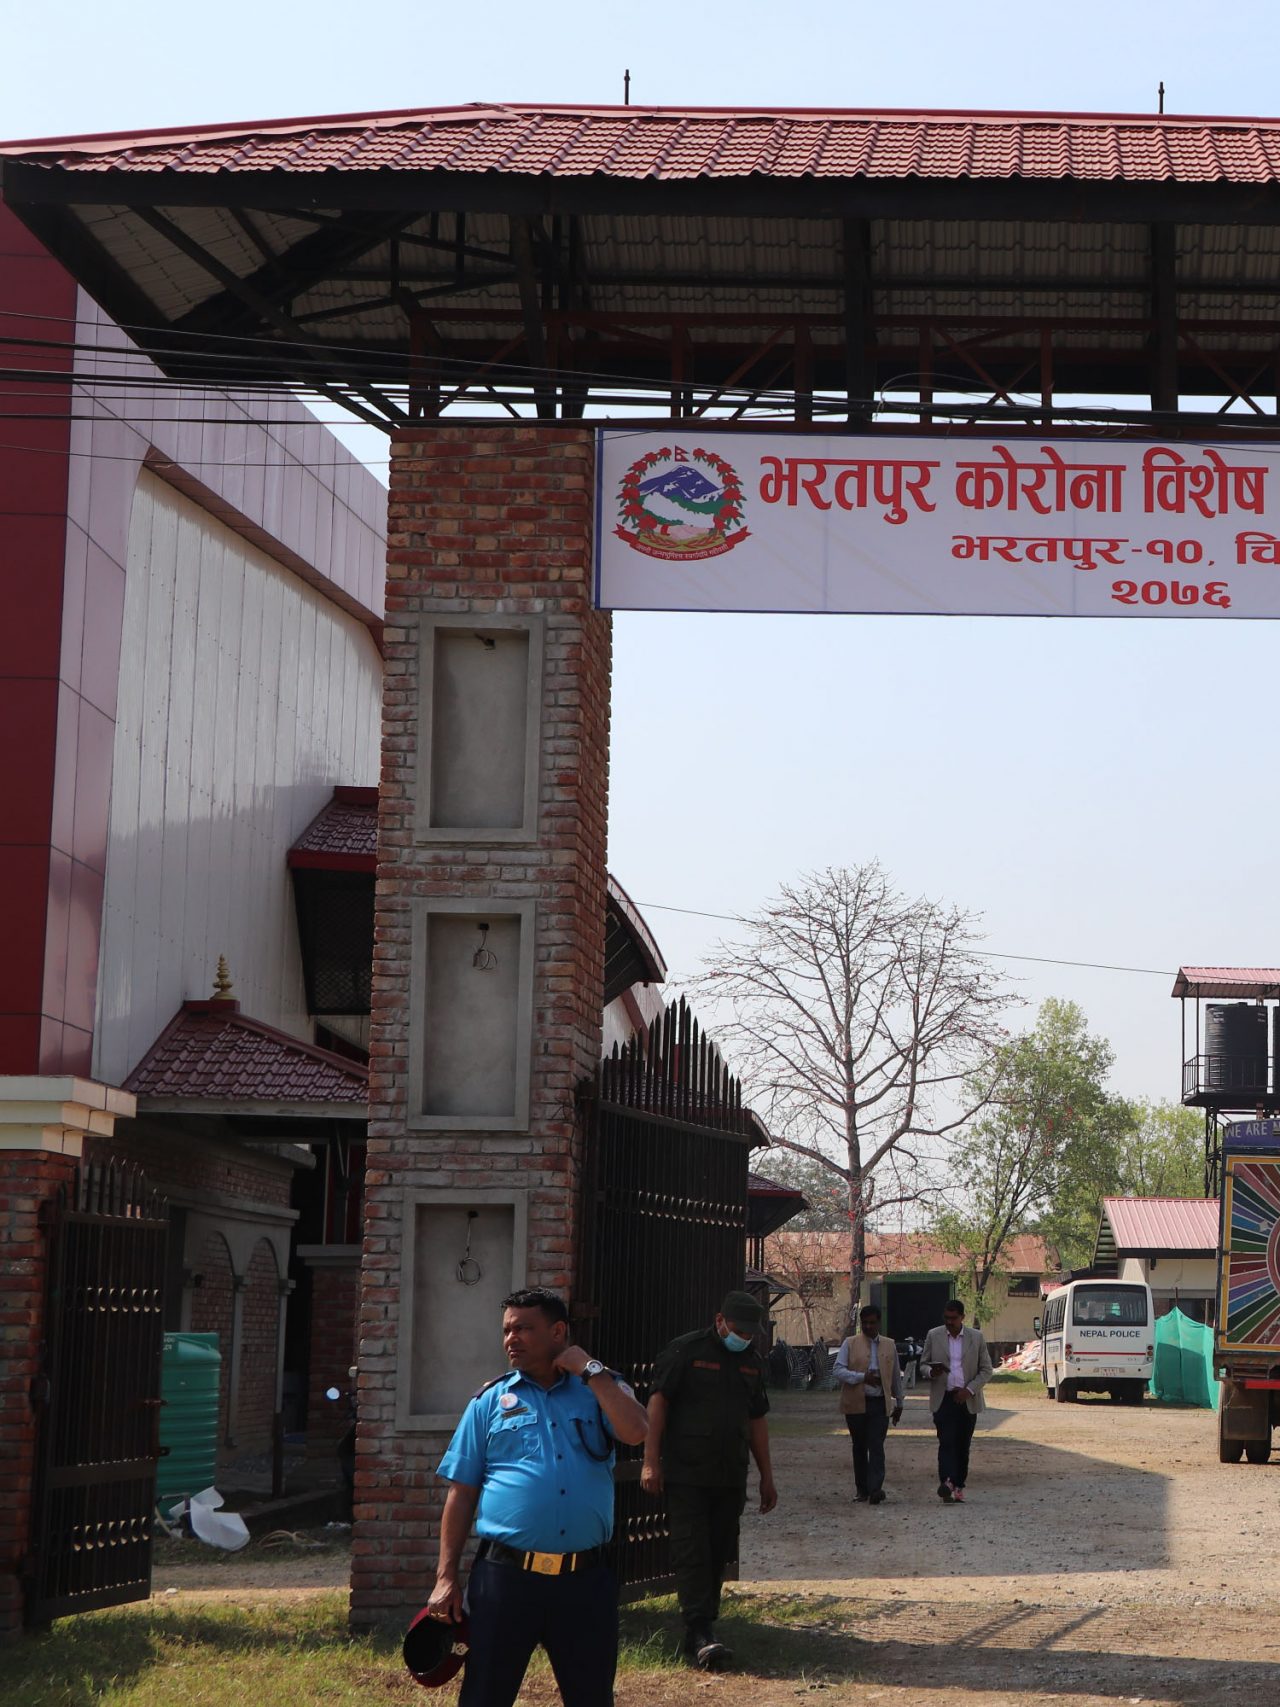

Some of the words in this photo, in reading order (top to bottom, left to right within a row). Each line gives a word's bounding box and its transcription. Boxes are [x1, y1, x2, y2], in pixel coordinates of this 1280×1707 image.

[760, 456, 940, 525] भरतपुर
[956, 446, 1127, 514] कोरोना
[1143, 447, 1268, 518] विशेष
[1111, 580, 1231, 609] २०७६
[1224, 1124, 1241, 1139] WE
[1246, 1121, 1268, 1136] ARE
[1080, 1330, 1108, 1338] NEPAL
[1110, 1330, 1141, 1338] POLICE
